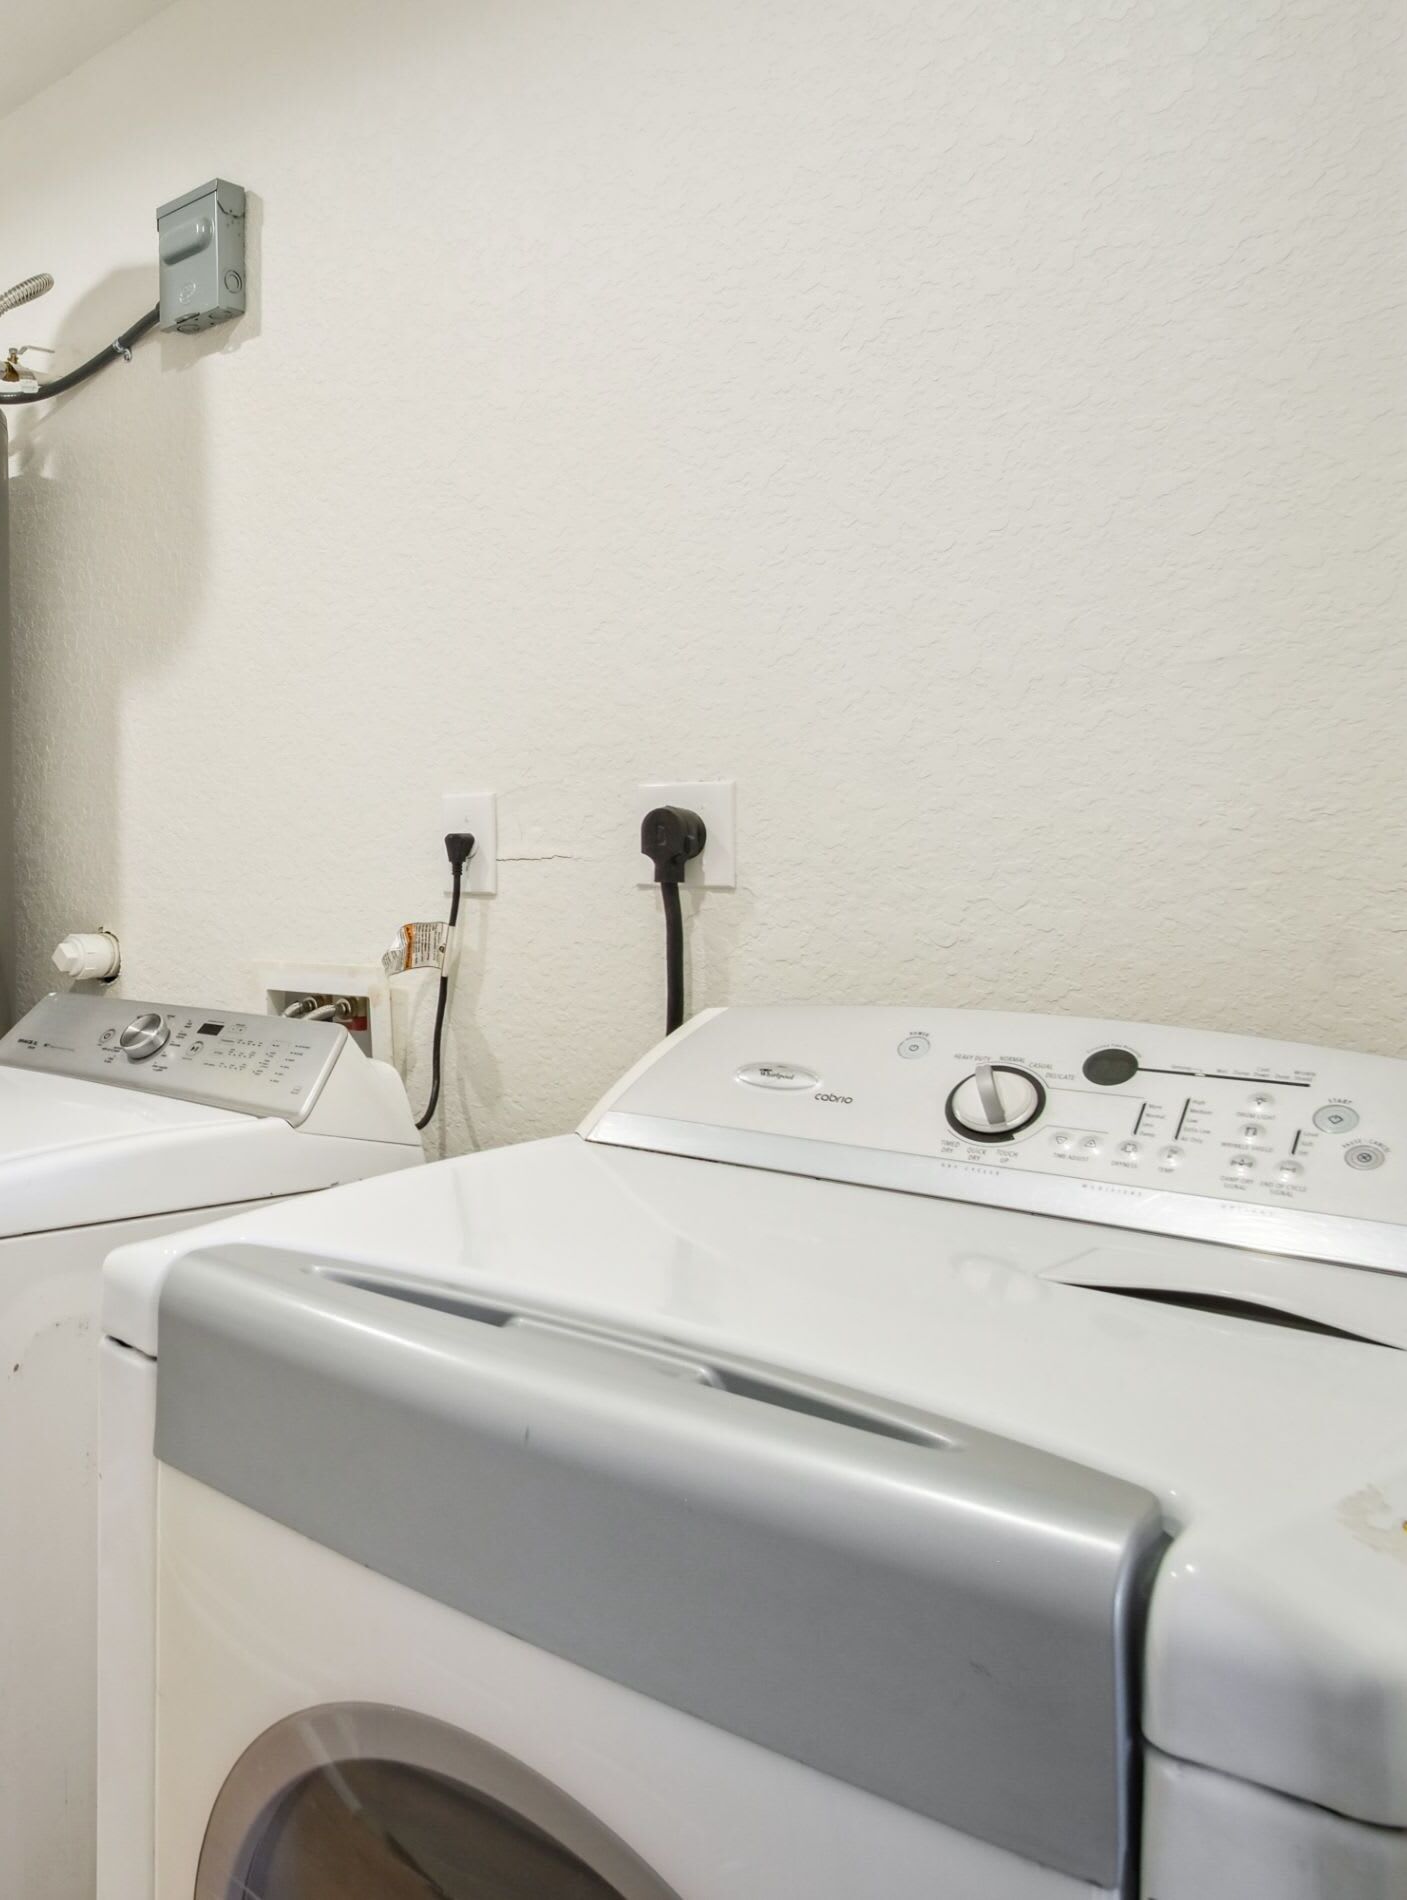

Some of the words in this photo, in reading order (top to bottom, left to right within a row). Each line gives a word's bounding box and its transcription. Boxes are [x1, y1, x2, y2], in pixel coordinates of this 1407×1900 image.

[1000, 1056, 1025, 1064] NORMAL
[1029, 1062, 1053, 1070] CASUAL
[1045, 1072, 1076, 1081] DELICATE
[814, 1093, 853, 1104] cabrio
